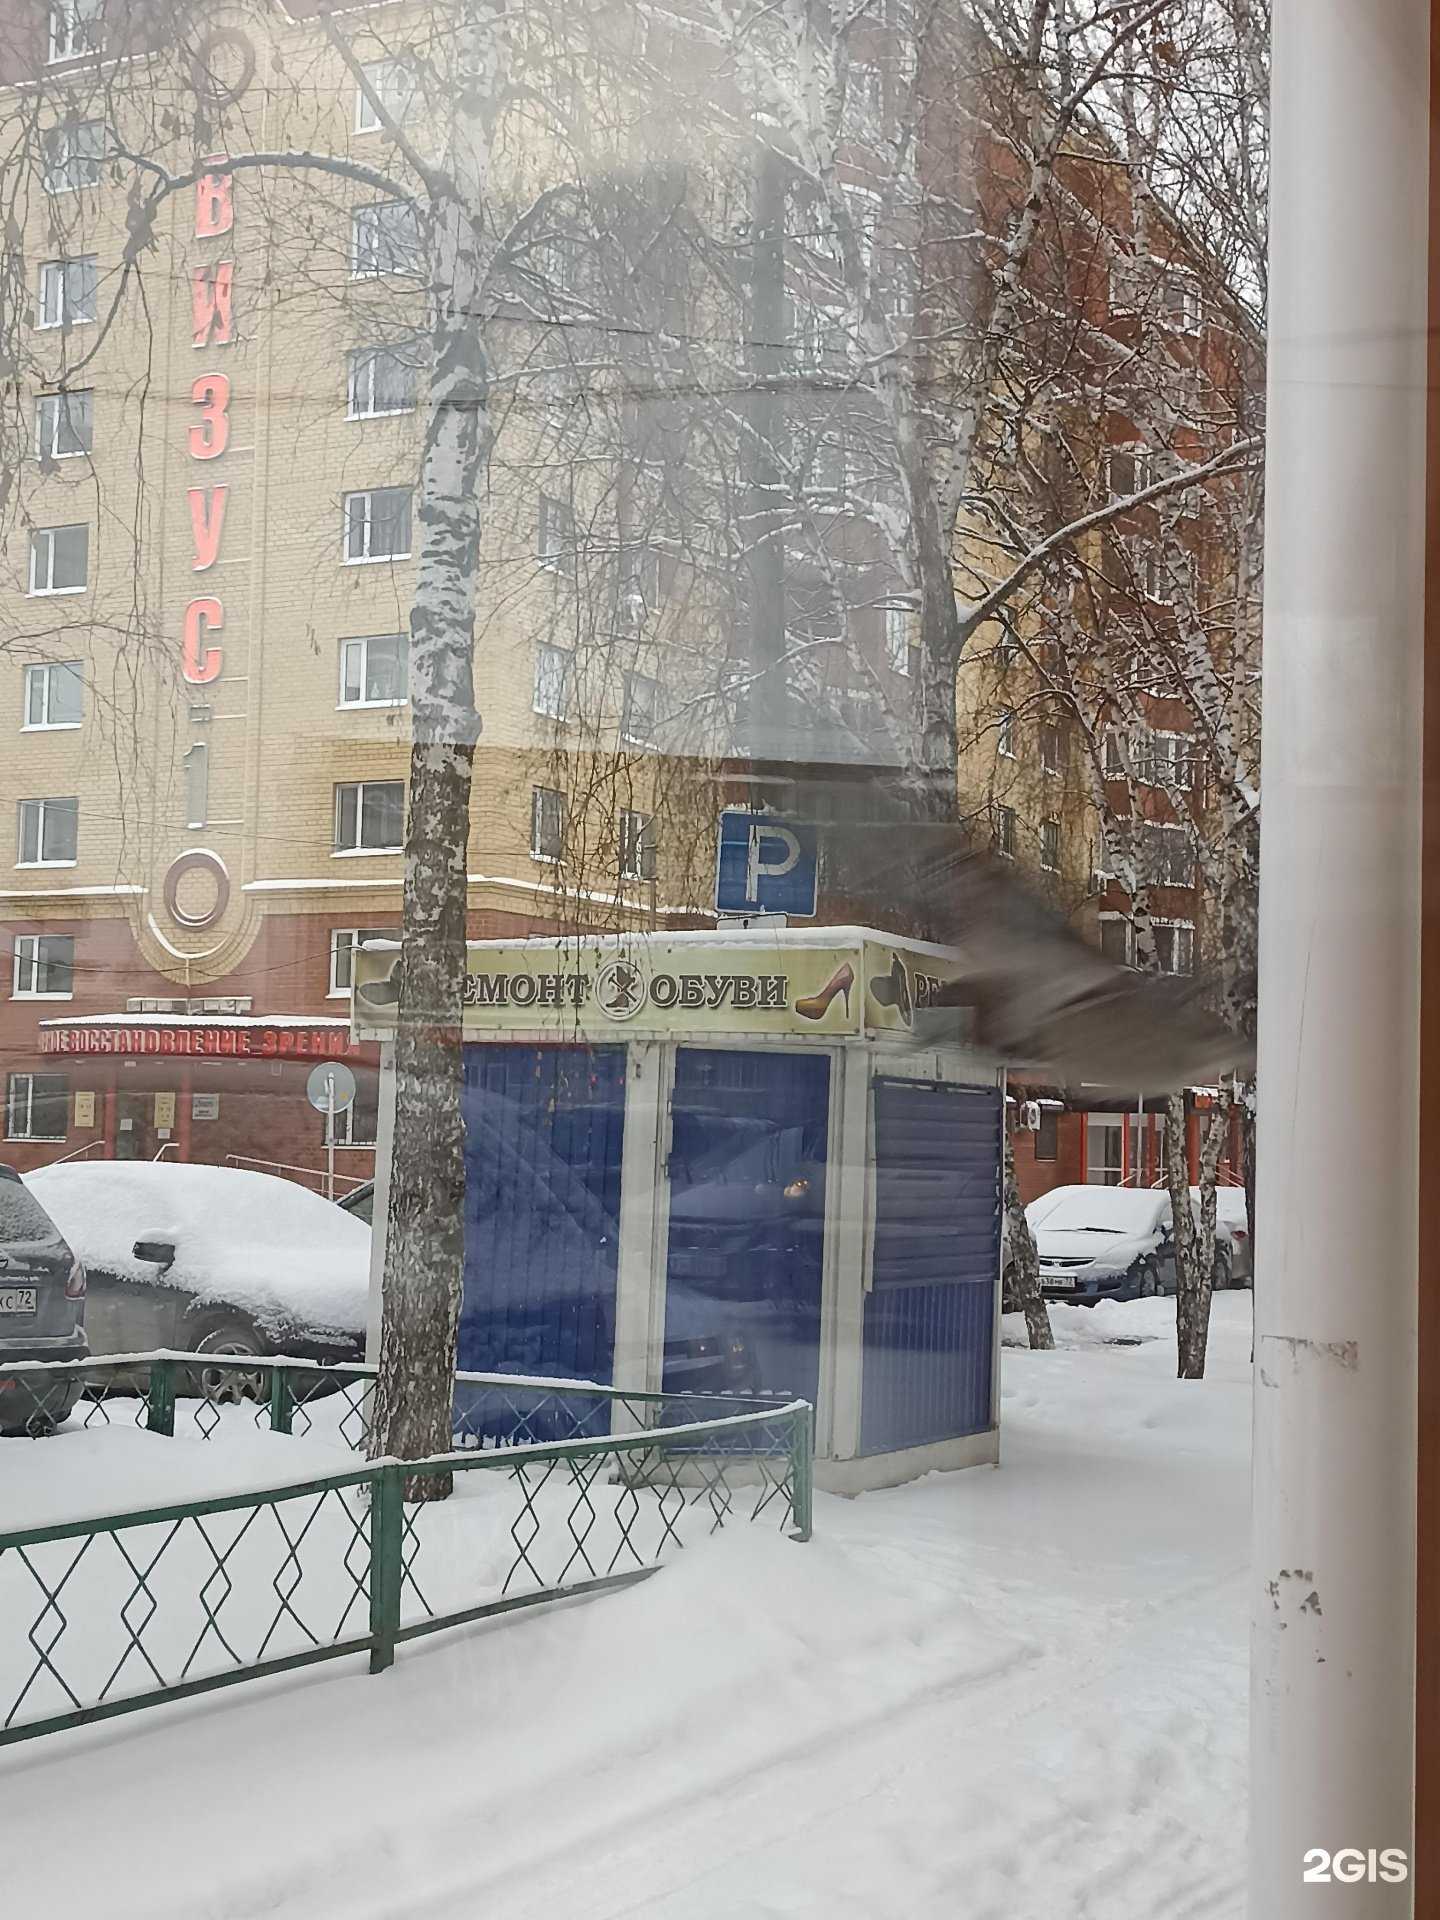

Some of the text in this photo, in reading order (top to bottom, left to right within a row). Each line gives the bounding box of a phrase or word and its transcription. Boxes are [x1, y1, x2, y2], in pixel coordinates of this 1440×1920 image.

[745, 824, 800, 902] P
[462, 974, 789, 1008] ЕМОНТ ОБУВИ
[18, 1290, 32, 1304] 72
